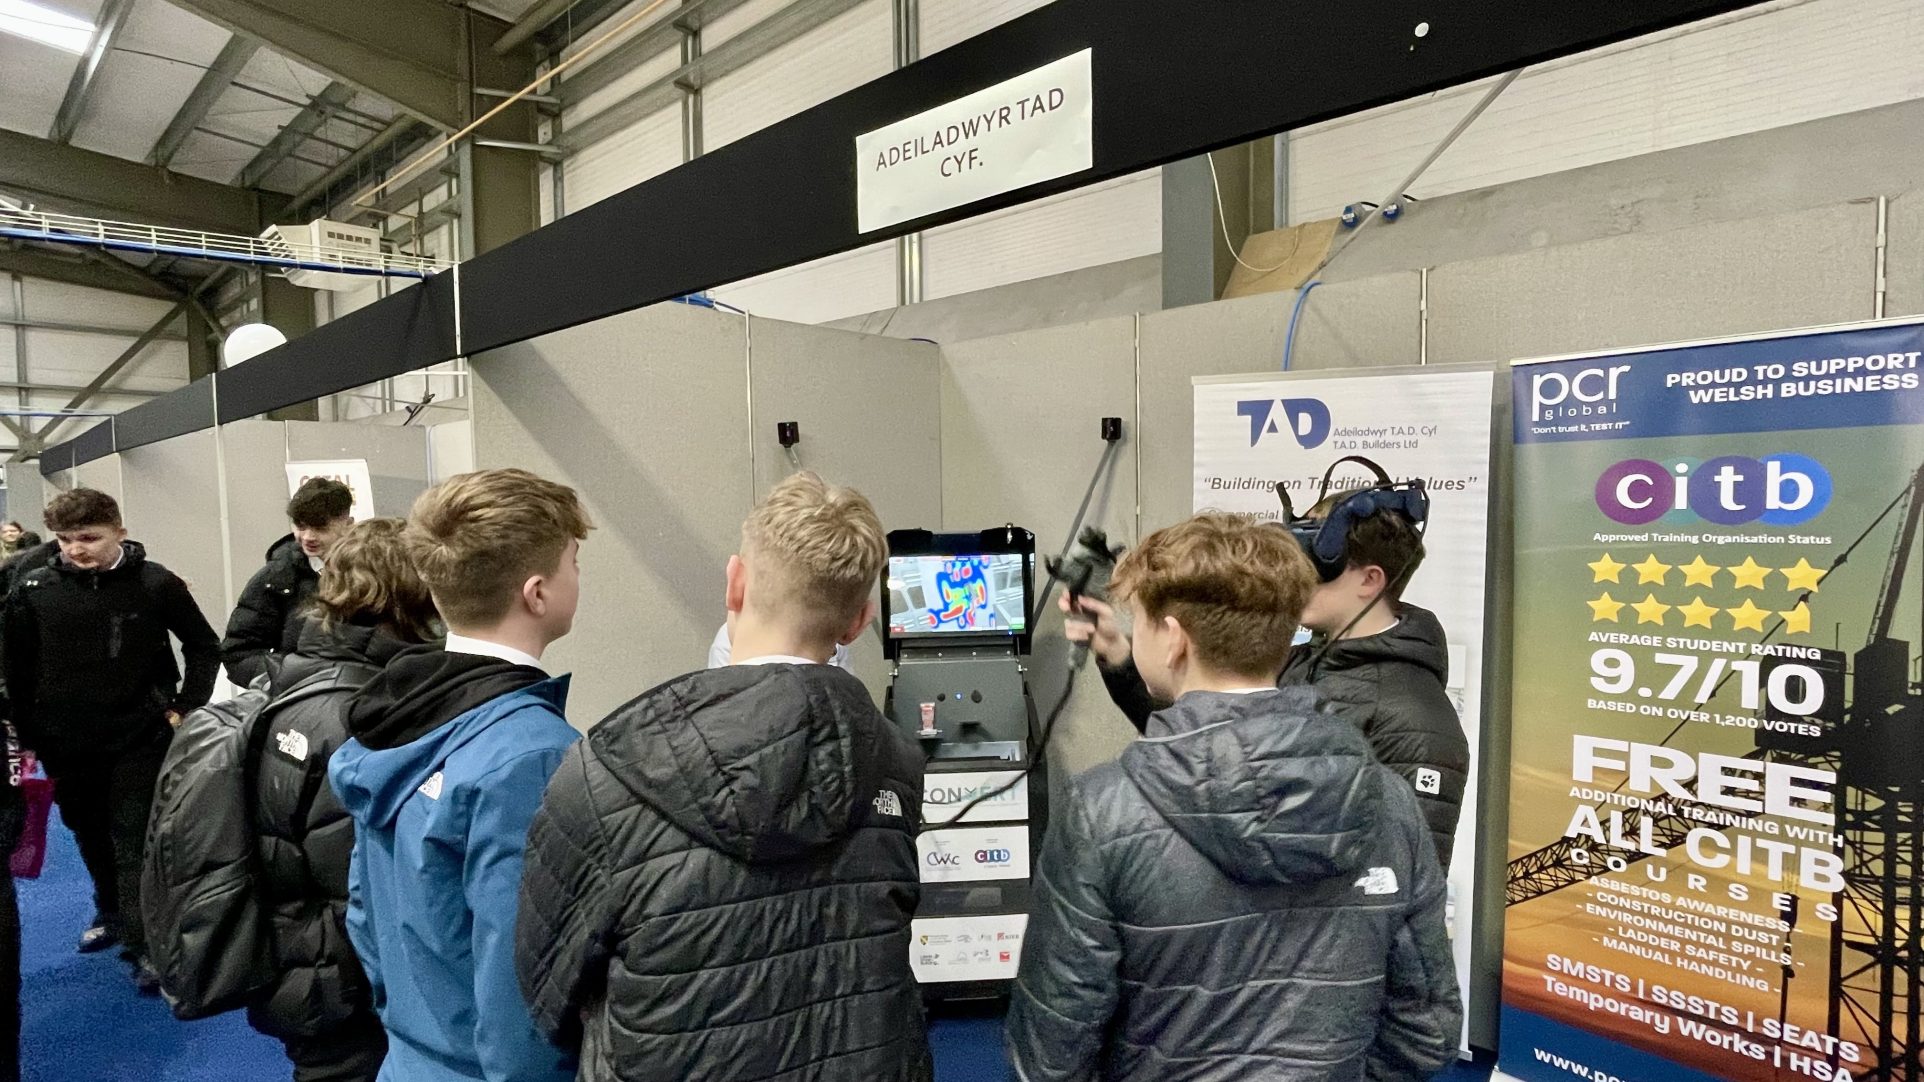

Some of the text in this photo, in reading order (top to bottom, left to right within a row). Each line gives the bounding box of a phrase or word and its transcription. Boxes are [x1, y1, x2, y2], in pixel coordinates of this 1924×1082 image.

[876, 87, 1064, 171] ADEILADWYR TAD
[940, 148, 983, 177] CYF.
[1531, 365, 1631, 421] pcr
[1666, 351, 1921, 388] PROUD TO SUPPORT
[1689, 373, 1919, 404] WELSH BUSINESS
[1237, 398, 1331, 449] TAD
[1333, 427, 1388, 438] Adeiladwyr
[1420, 425, 1437, 437] Cyf
[1544, 402, 1616, 420] global
[1558, 425, 1579, 433] trust
[1590, 423, 1613, 431] TEST
[1362, 440, 1401, 450] Builders
[1403, 439, 1418, 449] Ltd
[1283, 479, 1301, 490] on
[1616, 461, 1814, 511] citb
[1593, 532, 1832, 546] Approved Training Organisation Status
[1588, 632, 1822, 661] AVERAGE STUDENT RATING
[1589, 648, 1825, 716] 9.7/10
[1587, 698, 1822, 738] BASED ON OVER 1,200 VOTES
[1572, 734, 1837, 826] FREE
[1569, 786, 1844, 848] ADDITIONAL TRAINING WITH
[977, 850, 1009, 862] citb
[1565, 804, 1846, 893] ALL CITB
[1589, 875, 1672, 904] ASBESTOS
[1675, 896, 1791, 933] AWARENESS
[1596, 891, 1727, 933] CONSTRUCTION
[1731, 925, 1780, 946] DUST
[1586, 903, 1727, 949] ENVIRONMENTAL
[1731, 940, 1792, 966] SPILLS
[1618, 925, 1681, 952] LADDER
[1685, 943, 1752, 972] SAFETY
[1602, 936, 1672, 966] MANUAL
[1676, 958, 1769, 992] HANDLING
[1542, 975, 1671, 1034] Temporary
[1676, 1016, 1766, 1060] Works
[1546, 953, 1631, 994] SMSTS
[1651, 985, 1739, 1026] SSSTS
[1762, 1018, 1860, 1063] SEATS
